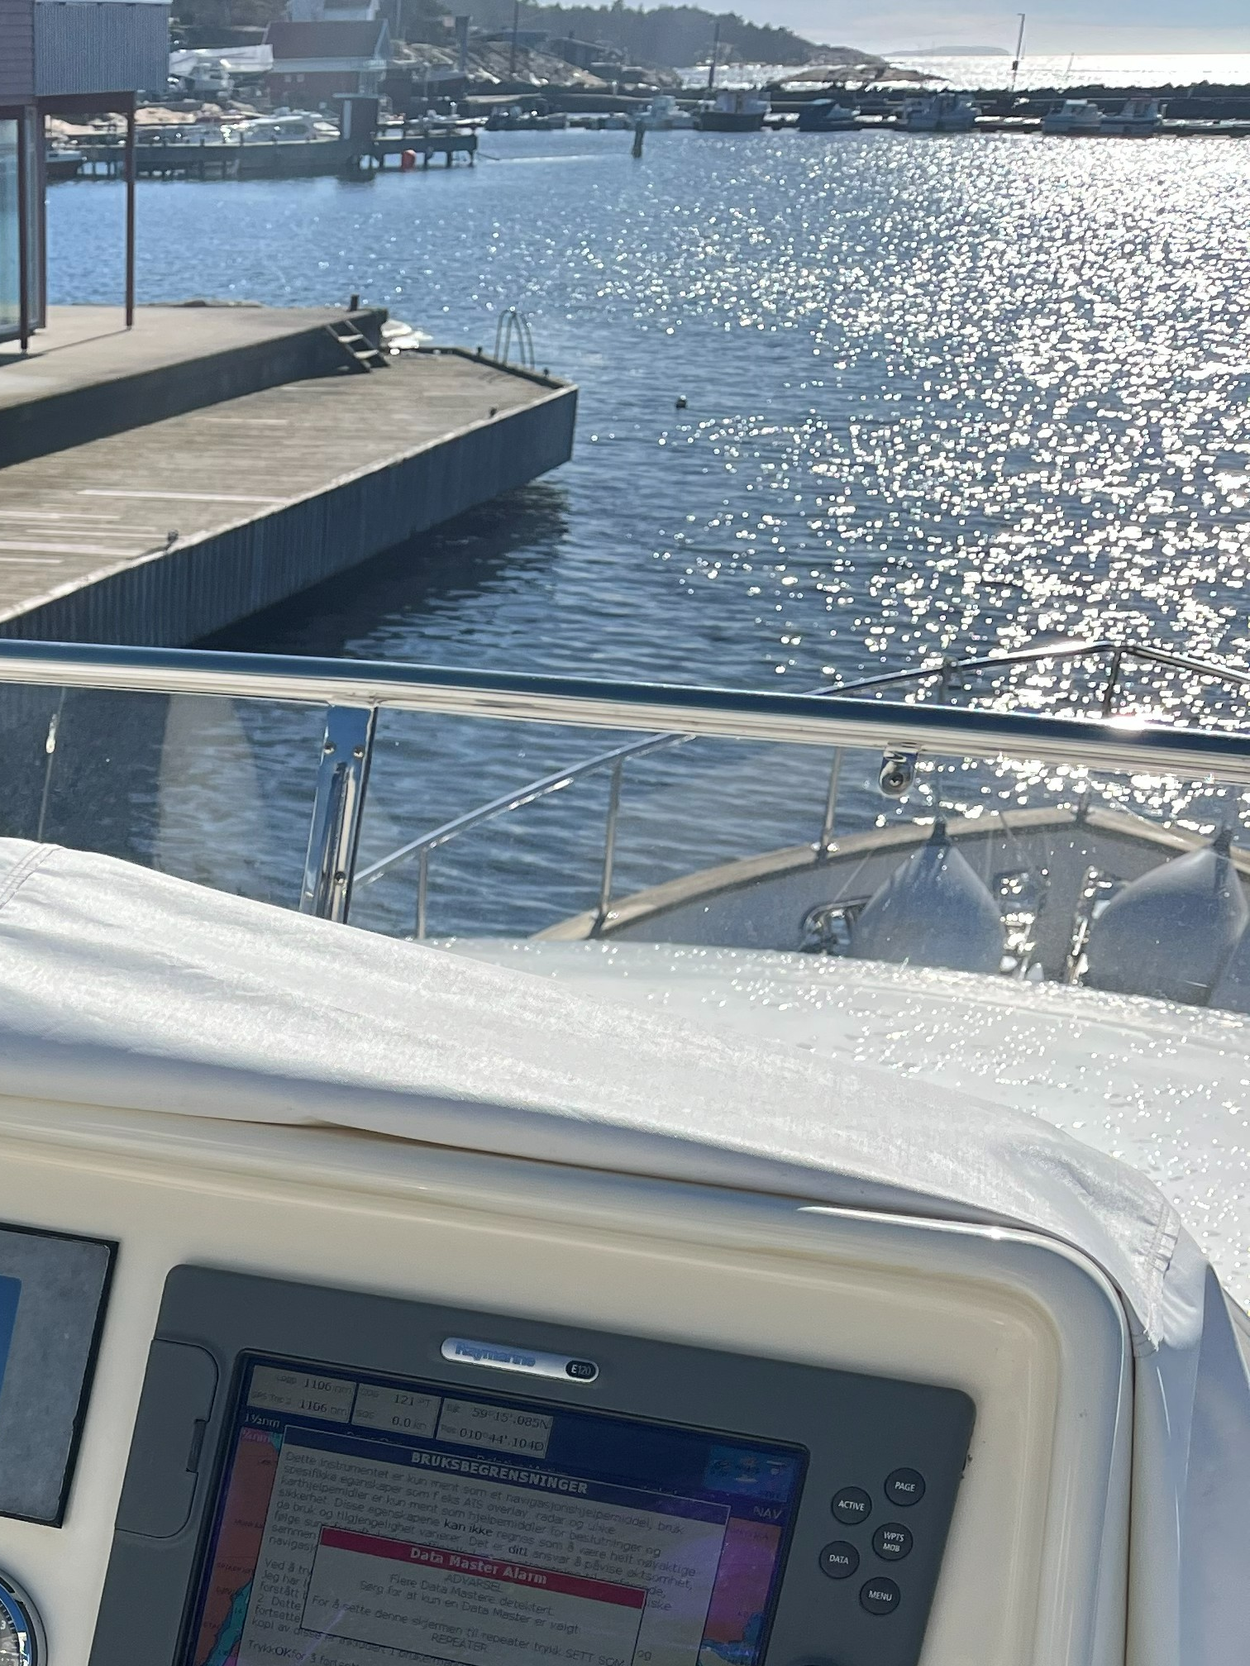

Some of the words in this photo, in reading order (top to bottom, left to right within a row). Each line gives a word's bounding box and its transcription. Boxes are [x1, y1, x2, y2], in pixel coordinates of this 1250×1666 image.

[571, 1364, 591, 1375] E120
[411, 1451, 588, 1494] BRUKSBEGRENSNINGER
[895, 1482, 916, 1492] PAGE
[838, 1500, 865, 1511] ACTIVE
[752, 1505, 782, 1520] NAV
[443, 1518, 467, 1532] kan
[468, 1523, 493, 1537] ikke
[884, 1532, 904, 1542] WPTS
[507, 1543, 529, 1556] ditt
[883, 1543, 900, 1552] MOB
[409, 1547, 444, 1564] Data
[448, 1554, 498, 1575] Master
[502, 1565, 547, 1584] Alarm
[829, 1555, 848, 1564] DATA
[390, 1573, 418, 1588] Flere
[420, 1579, 448, 1594] Data
[450, 1585, 496, 1604] Mastere
[869, 1591, 892, 1601] MENU
[387, 1585, 402, 1597] for
[420, 1592, 441, 1605] kun
[444, 1596, 459, 1609] en
[461, 1600, 490, 1615] Data
[492, 1606, 532, 1624] Master
[0, 1620, 6, 1629] 3
[311, 1594, 329, 1607] For
[342, 1600, 371, 1616] sette
[374, 1607, 408, 1624] denne
[479, 1629, 530, 1651] repeater
[564, 1647, 594, 1663] SETT
[430, 1632, 487, 1653] REPEATER
